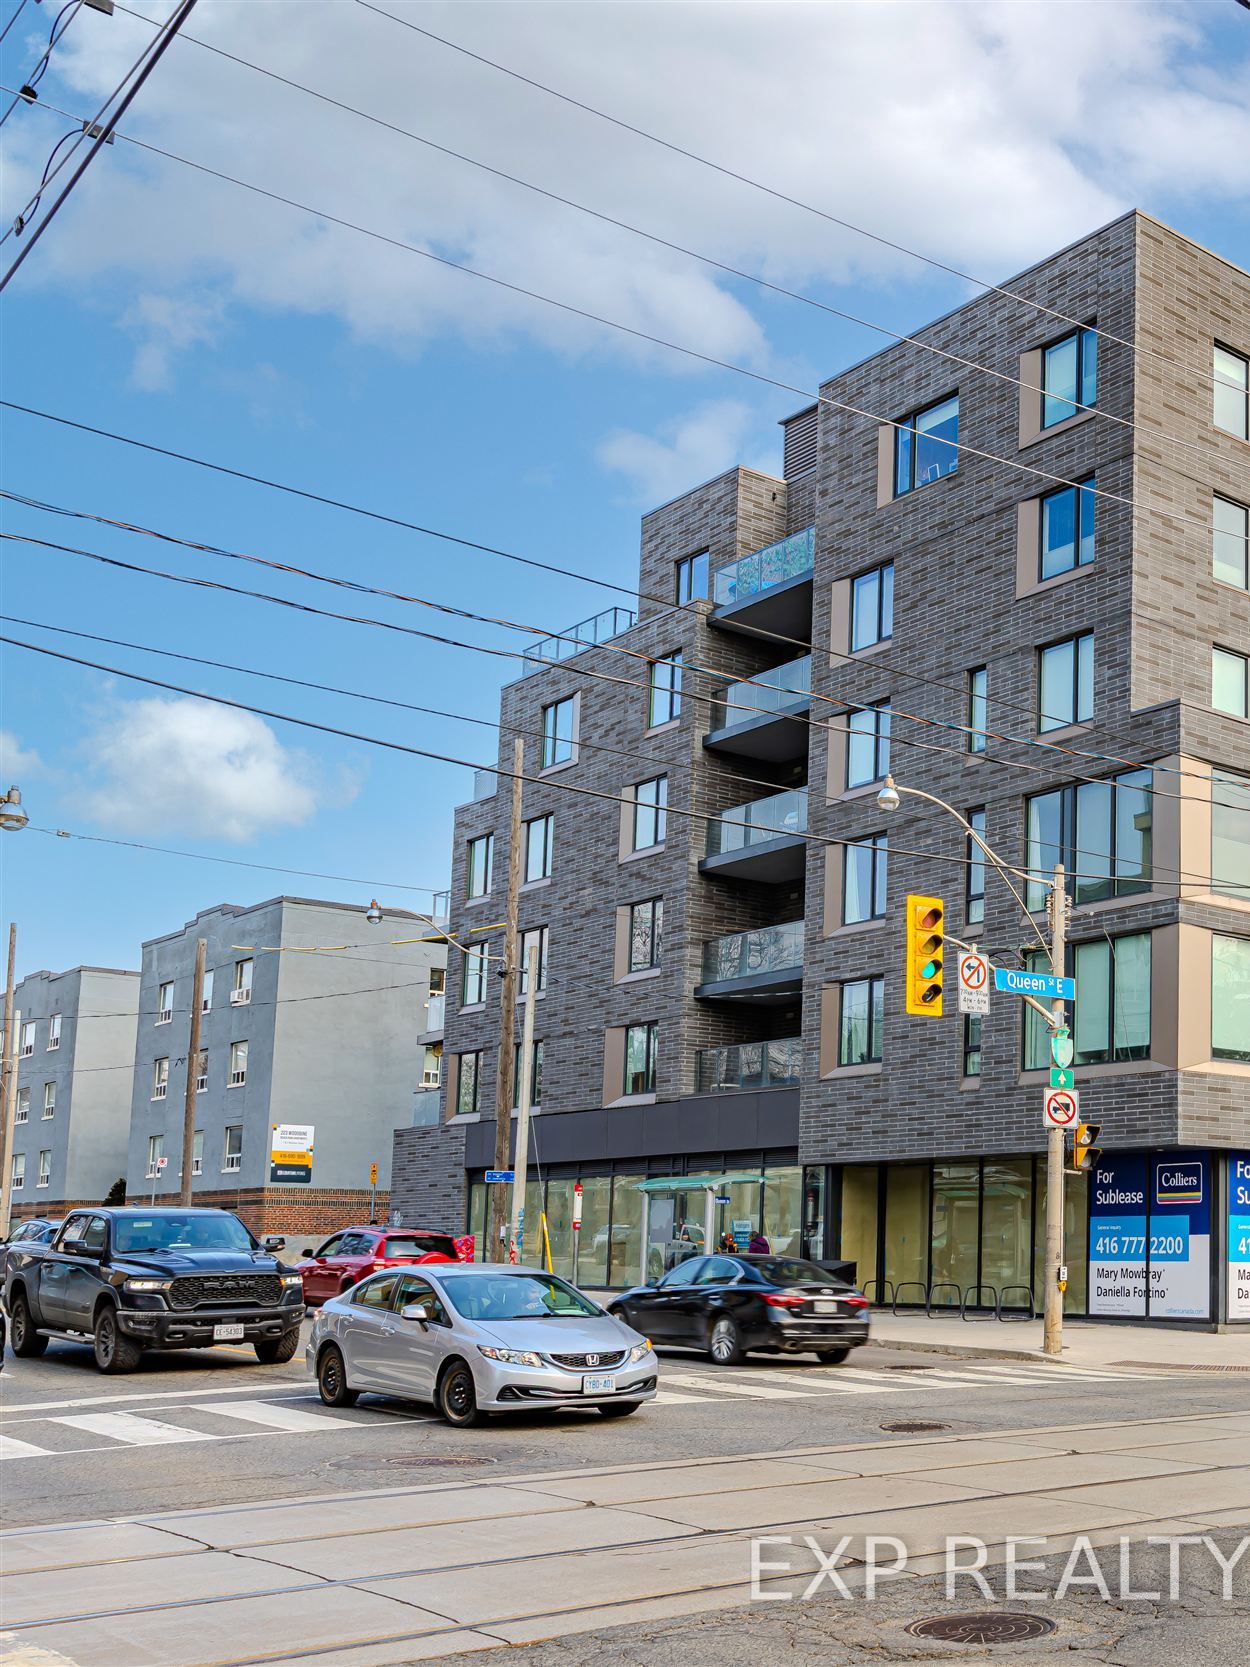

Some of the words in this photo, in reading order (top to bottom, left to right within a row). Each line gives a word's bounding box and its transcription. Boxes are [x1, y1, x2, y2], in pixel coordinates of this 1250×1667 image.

[1007, 972, 1045, 991] Queen
[1048, 977, 1054, 986] St
[1056, 979, 1063, 993] E
[1097, 1169, 1114, 1184] For
[1162, 1172, 1197, 1187] Colliers
[1096, 1190, 1143, 1204] Sublease
[1096, 1236, 1118, 1254] 416
[1121, 1236, 1146, 1253] 777
[1150, 1236, 1183, 1254] 2200
[1097, 1268, 1118, 1282] Mary
[203, 1281, 255, 1289] RAM
[1097, 1285, 1131, 1297] Daniella
